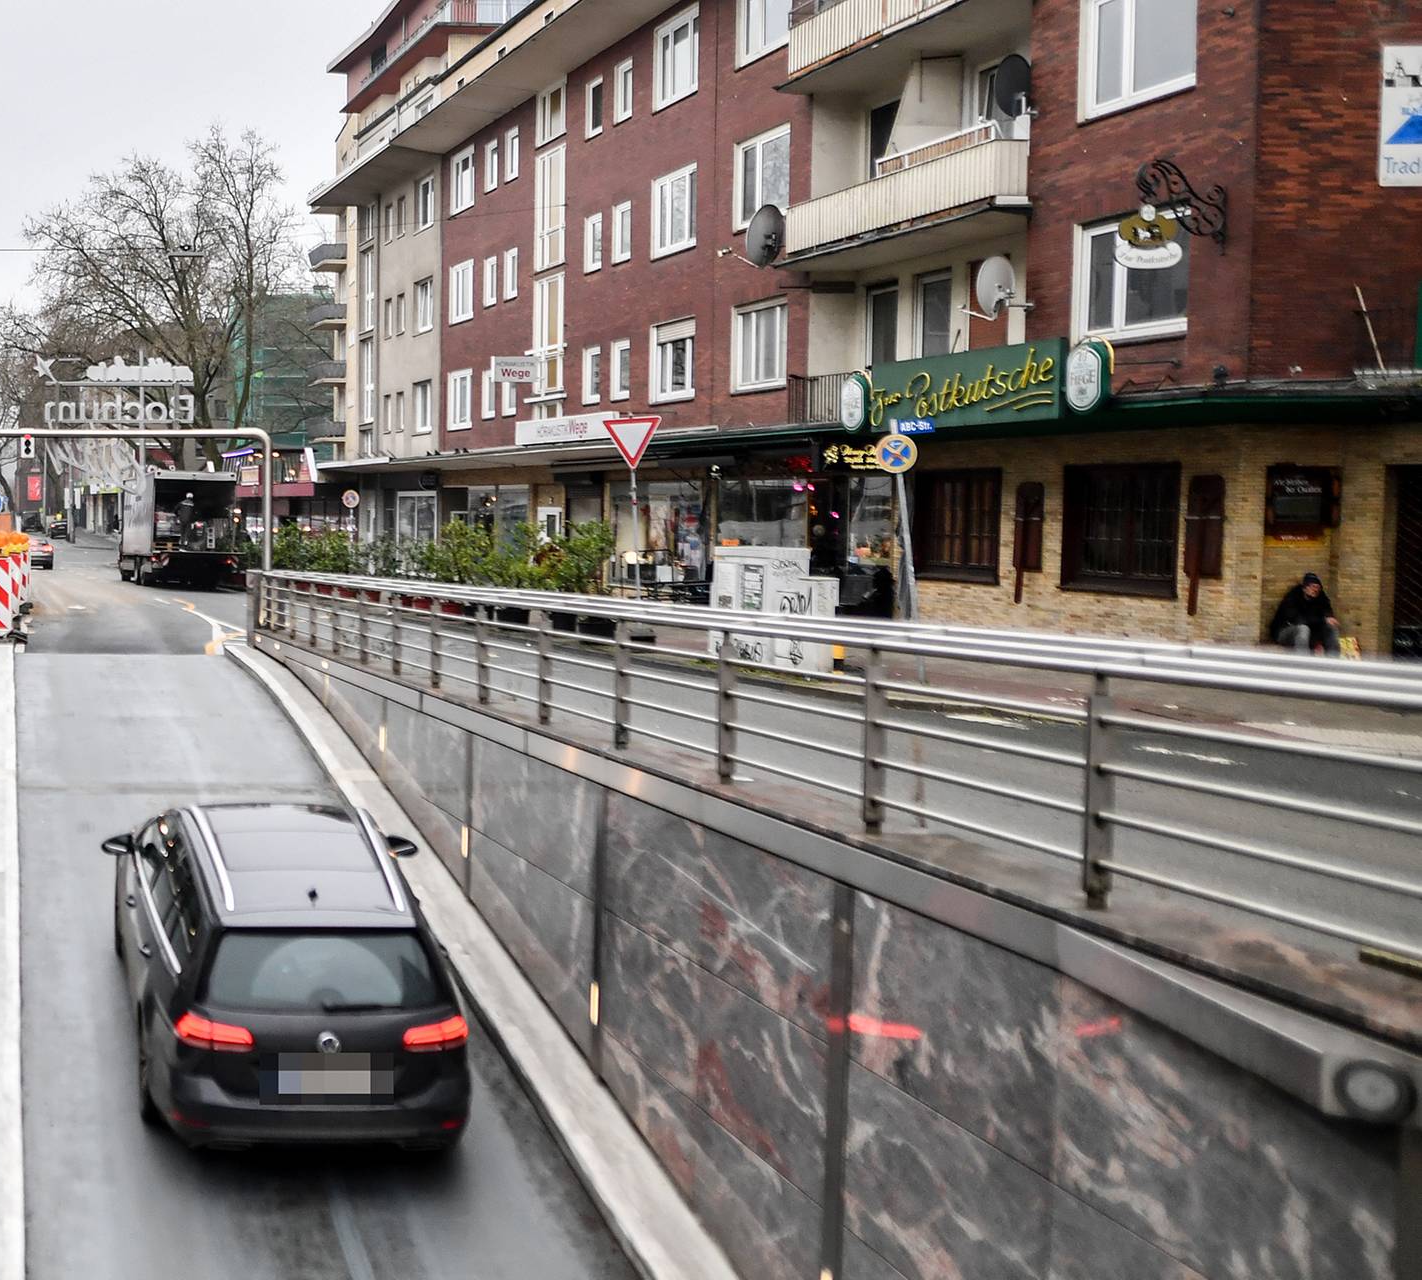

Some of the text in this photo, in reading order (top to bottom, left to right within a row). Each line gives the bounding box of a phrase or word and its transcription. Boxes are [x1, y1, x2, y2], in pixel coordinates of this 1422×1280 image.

[501, 368, 531, 380] Wege
[906, 348, 1054, 419] Postkutsche
[900, 421, 933, 432] ABC-Str.
